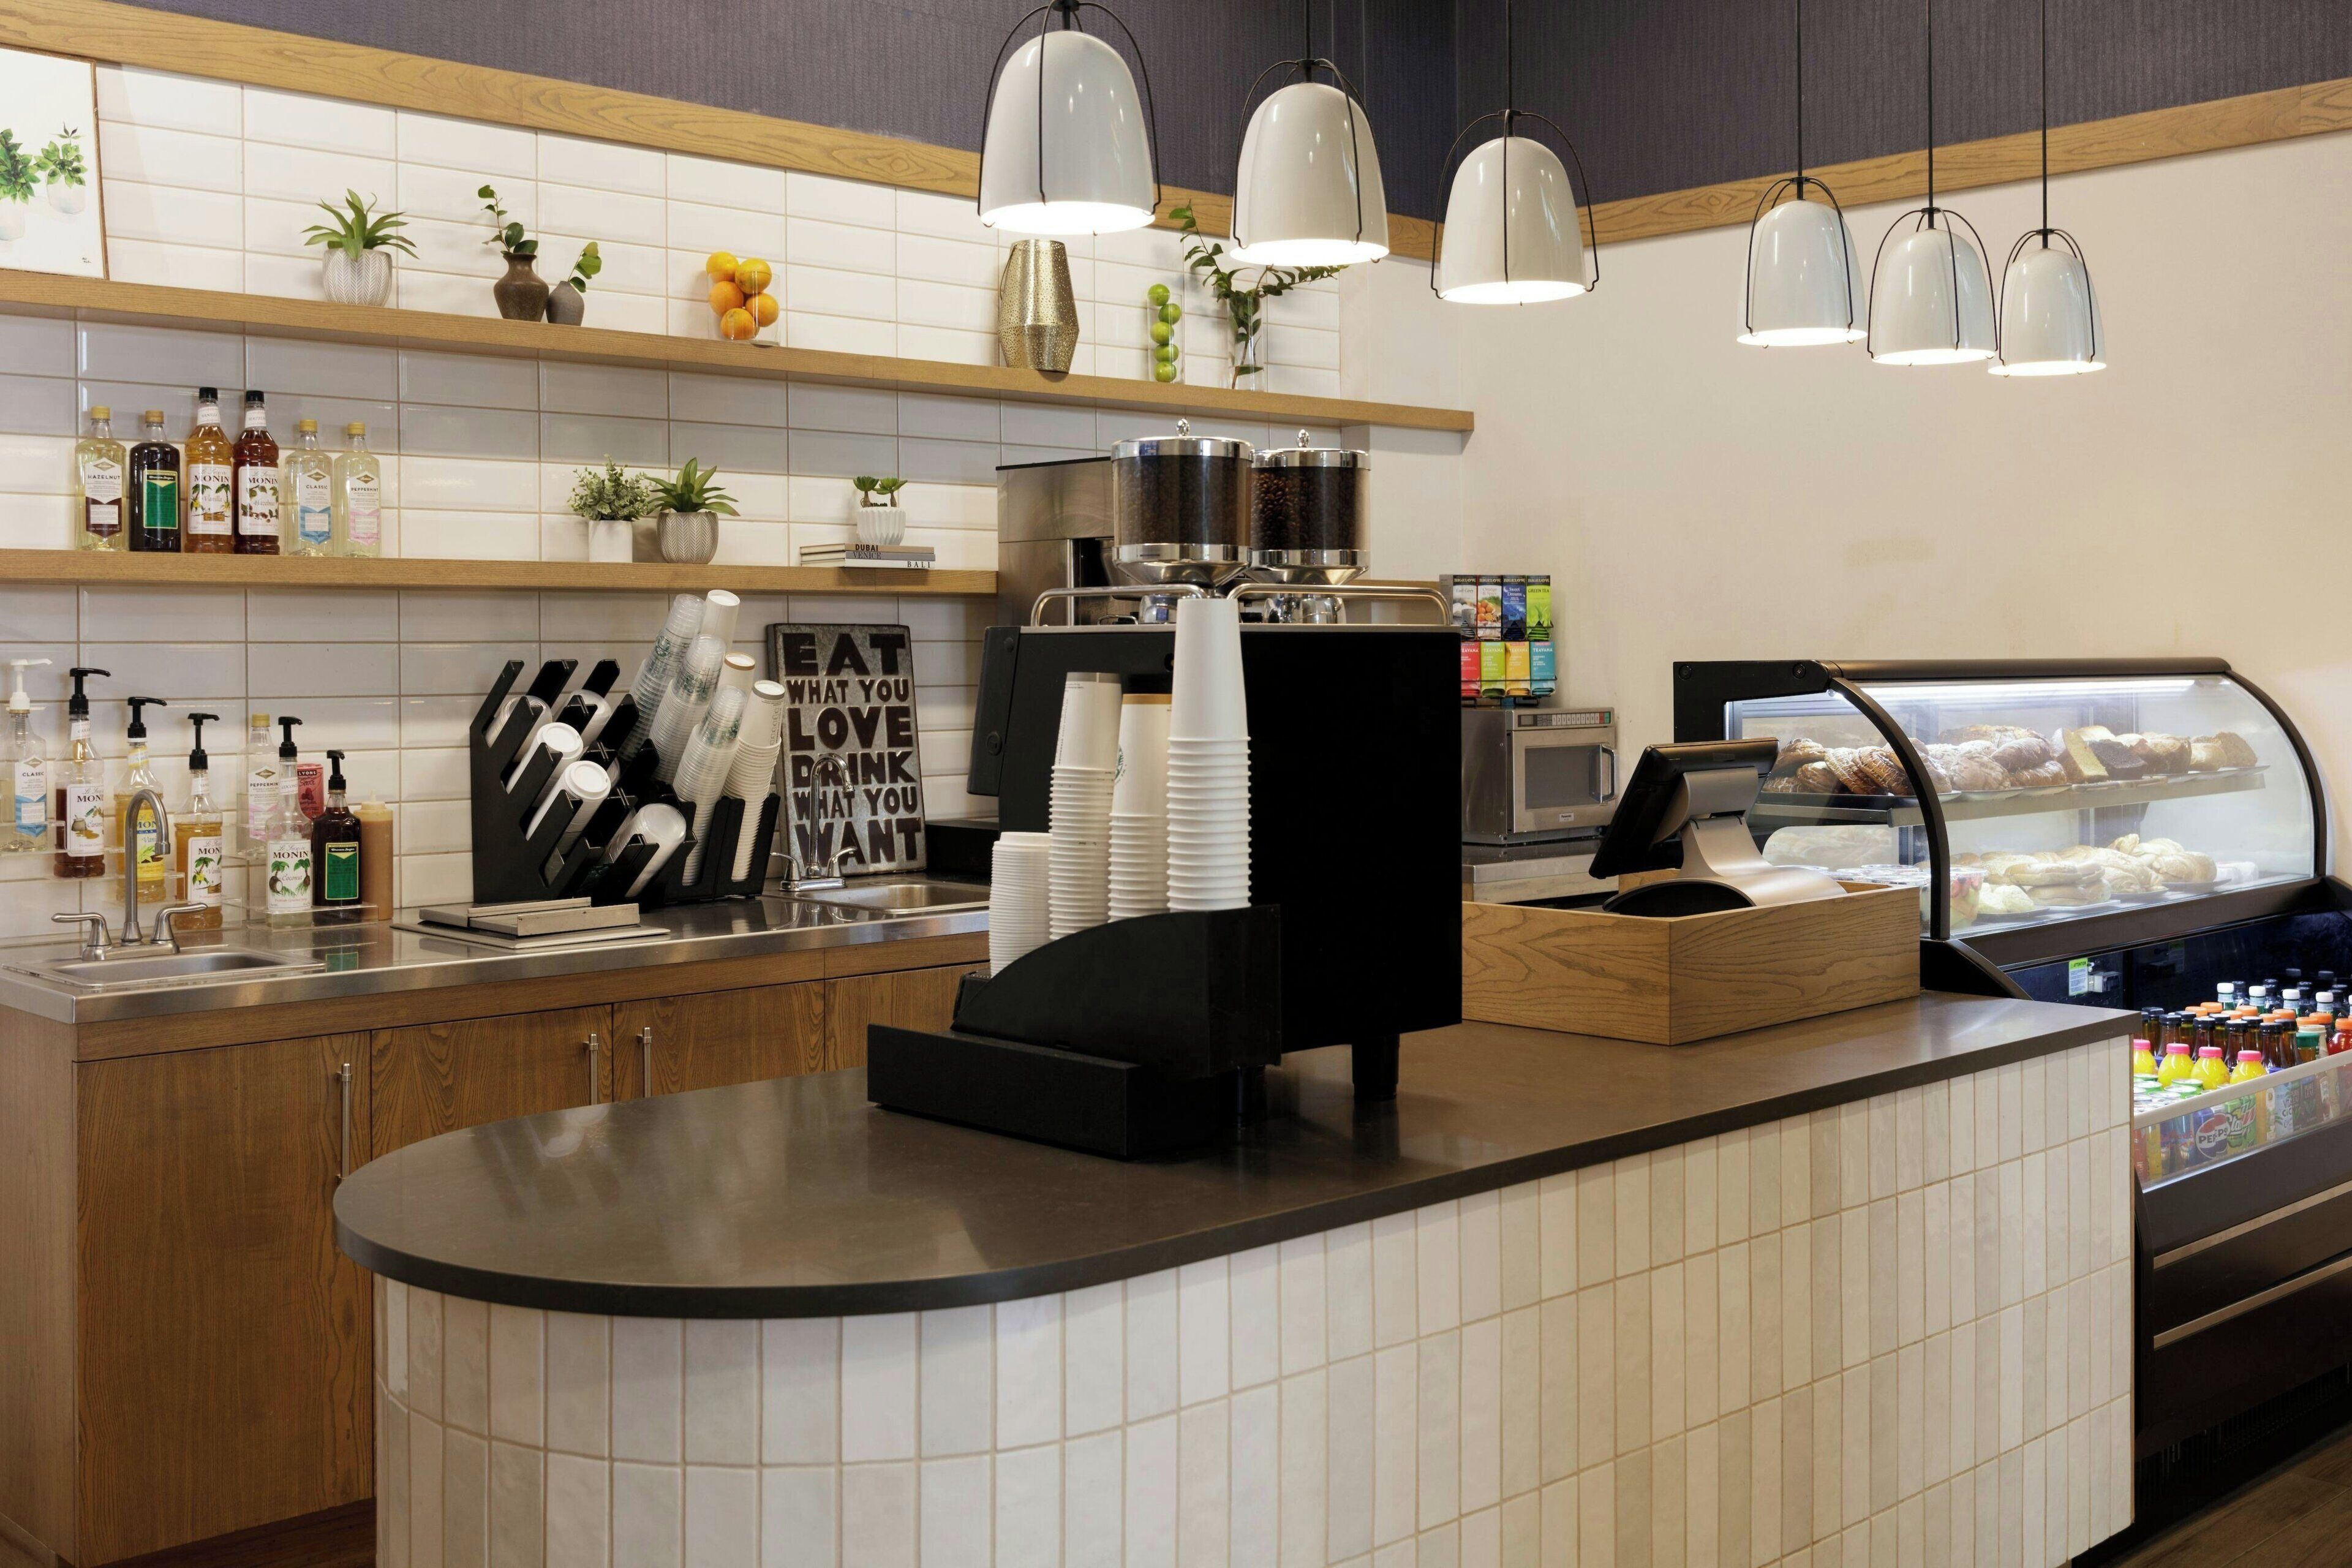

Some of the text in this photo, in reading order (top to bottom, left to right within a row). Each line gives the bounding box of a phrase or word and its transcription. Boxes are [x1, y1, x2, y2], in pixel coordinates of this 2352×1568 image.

[855, 543, 878, 552] DUBAI
[782, 632, 906, 676] EAT
[786, 678, 910, 704] WHAT YOU
[787, 706, 913, 751] LOVE
[791, 750, 917, 788] DRINK
[793, 785, 918, 821] WHAT YOU
[273, 850, 309, 859] MONIN
[794, 816, 921, 867] WANT
